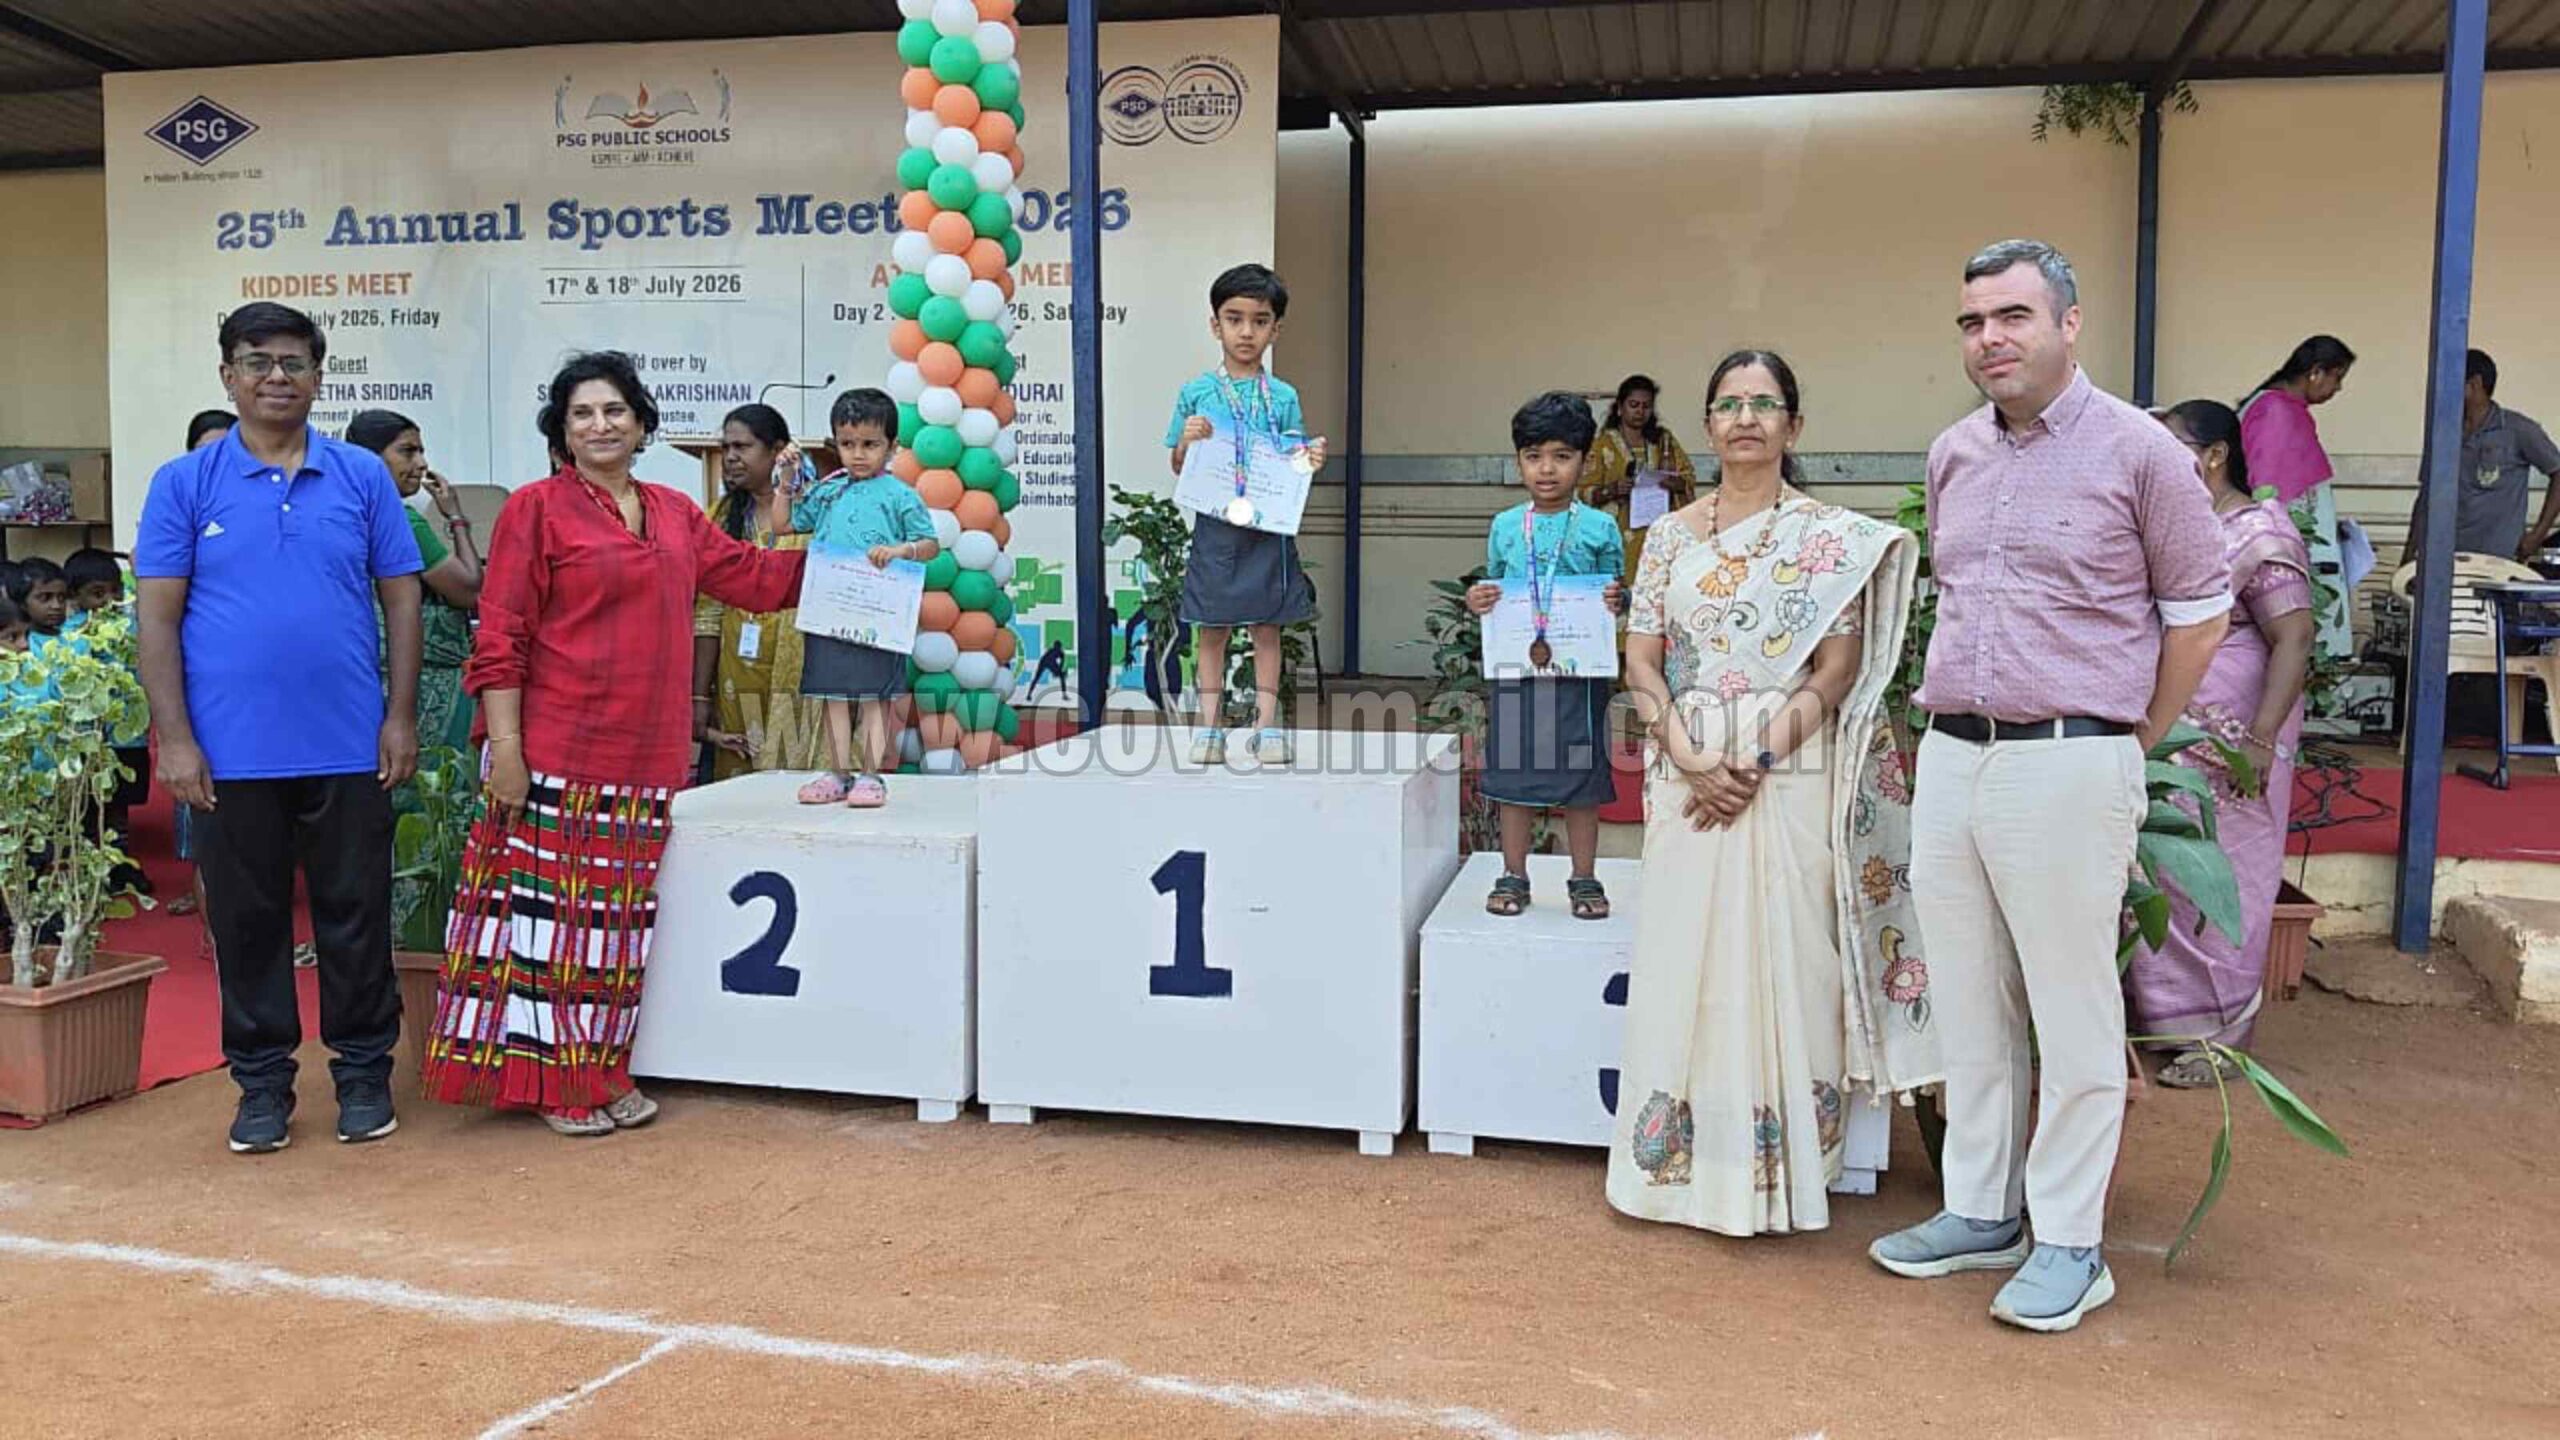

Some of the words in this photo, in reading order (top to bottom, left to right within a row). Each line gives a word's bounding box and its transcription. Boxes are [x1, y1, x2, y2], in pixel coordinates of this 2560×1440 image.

[174, 117, 228, 144] PSG
[556, 133, 587, 147] PSG
[592, 131, 652, 147] PUBLIC
[655, 127, 731, 144] SCHOOLS
[216, 206, 307, 250] 25th
[324, 202, 527, 247] Annual
[546, 198, 733, 251] Sports
[754, 192, 904, 237] Meet
[241, 274, 339, 299] KIDDIES
[347, 272, 413, 296] MEET
[585, 276, 599, 295] &
[645, 275, 686, 298] July
[692, 274, 742, 294] 2026
[391, 307, 441, 329] Friday
[833, 303, 867, 325] Day
[873, 303, 884, 321] 2
[327, 355, 368, 371] Guest
[651, 357, 685, 370] over
[689, 353, 707, 373] by
[318, 383, 357, 401] ETHA
[361, 382, 433, 401] SRIDHAR
[655, 383, 752, 401] AKRISHNAN
[1006, 383, 1064, 402] DURAI
[1023, 450, 1073, 465] Educati
[1021, 491, 1076, 507] oimbato
[720, 870, 800, 997] 2
[1149, 850, 1233, 998] 1
